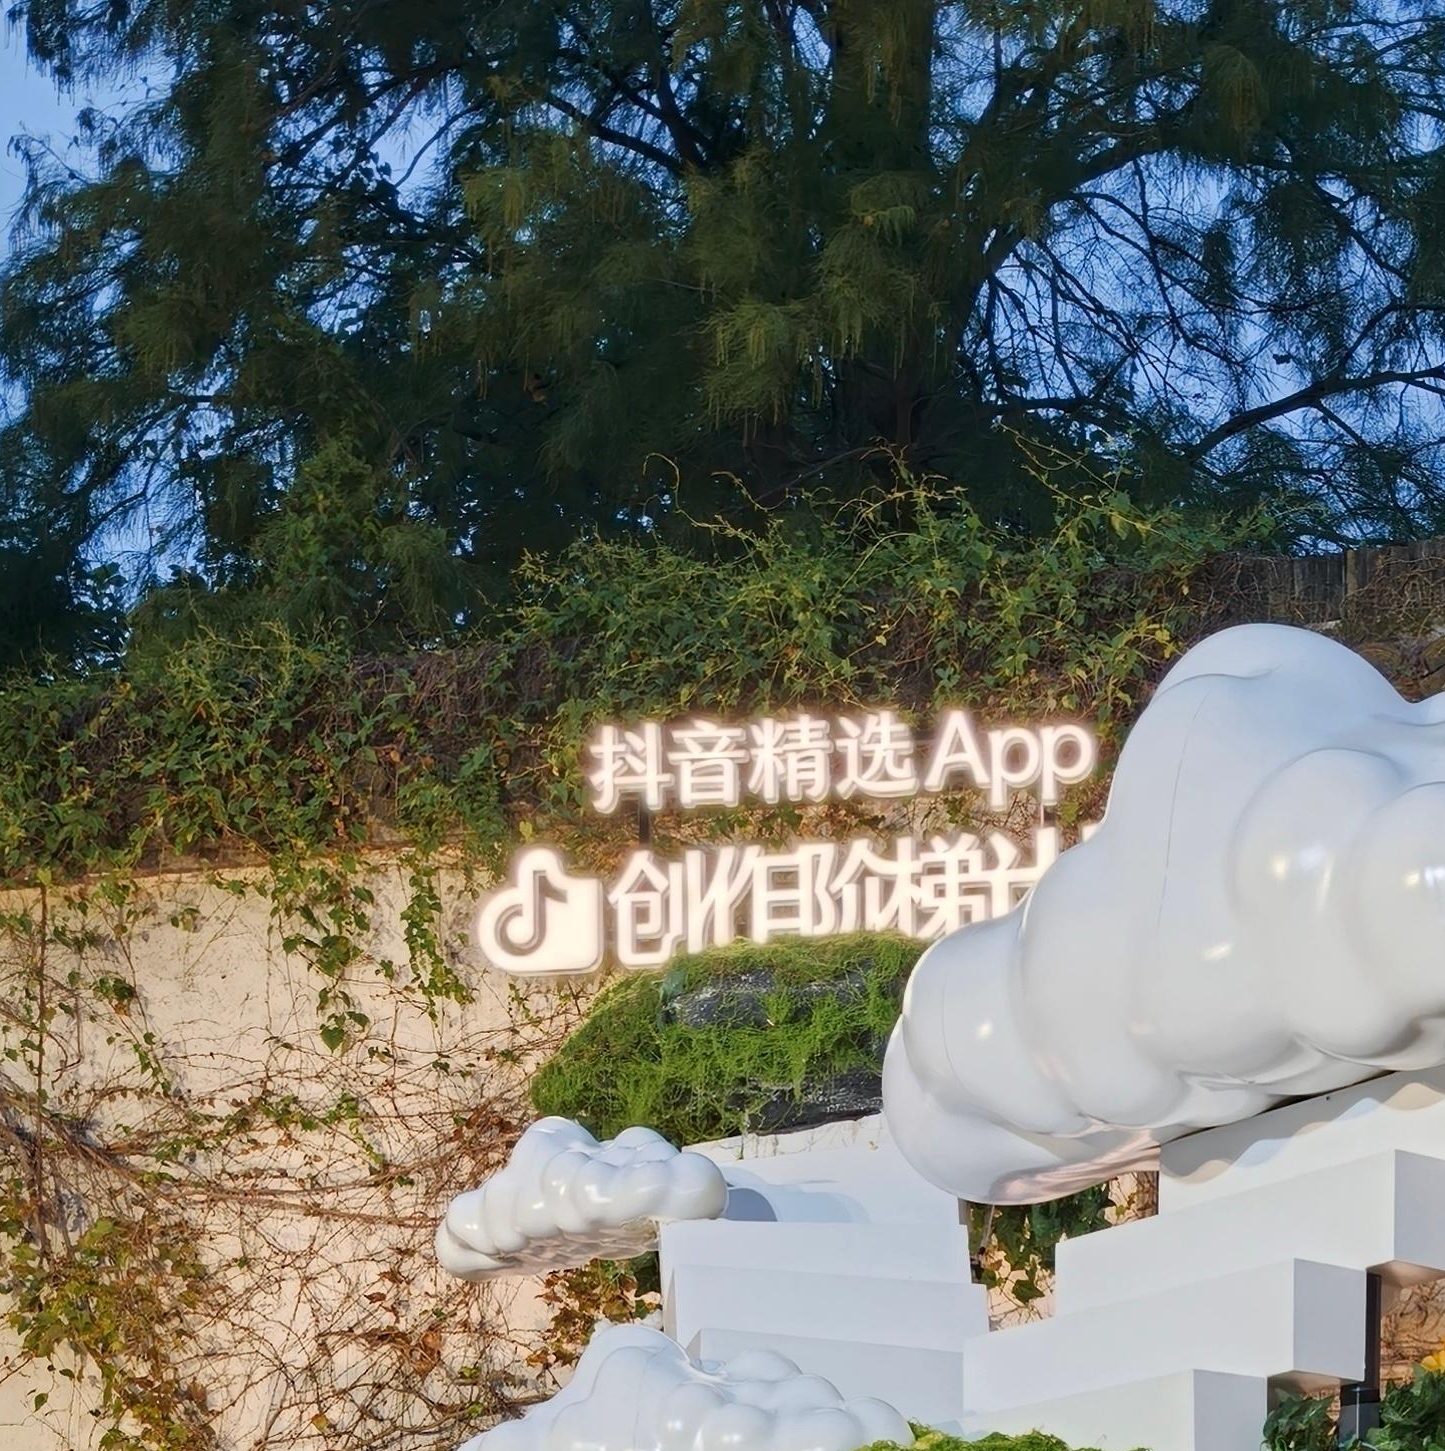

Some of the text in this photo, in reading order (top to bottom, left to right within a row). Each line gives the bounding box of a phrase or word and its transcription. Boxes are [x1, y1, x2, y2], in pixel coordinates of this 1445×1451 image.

[589, 709, 1097, 814] 抖音精选App
[608, 822, 1099, 967] 创作阶梯计
